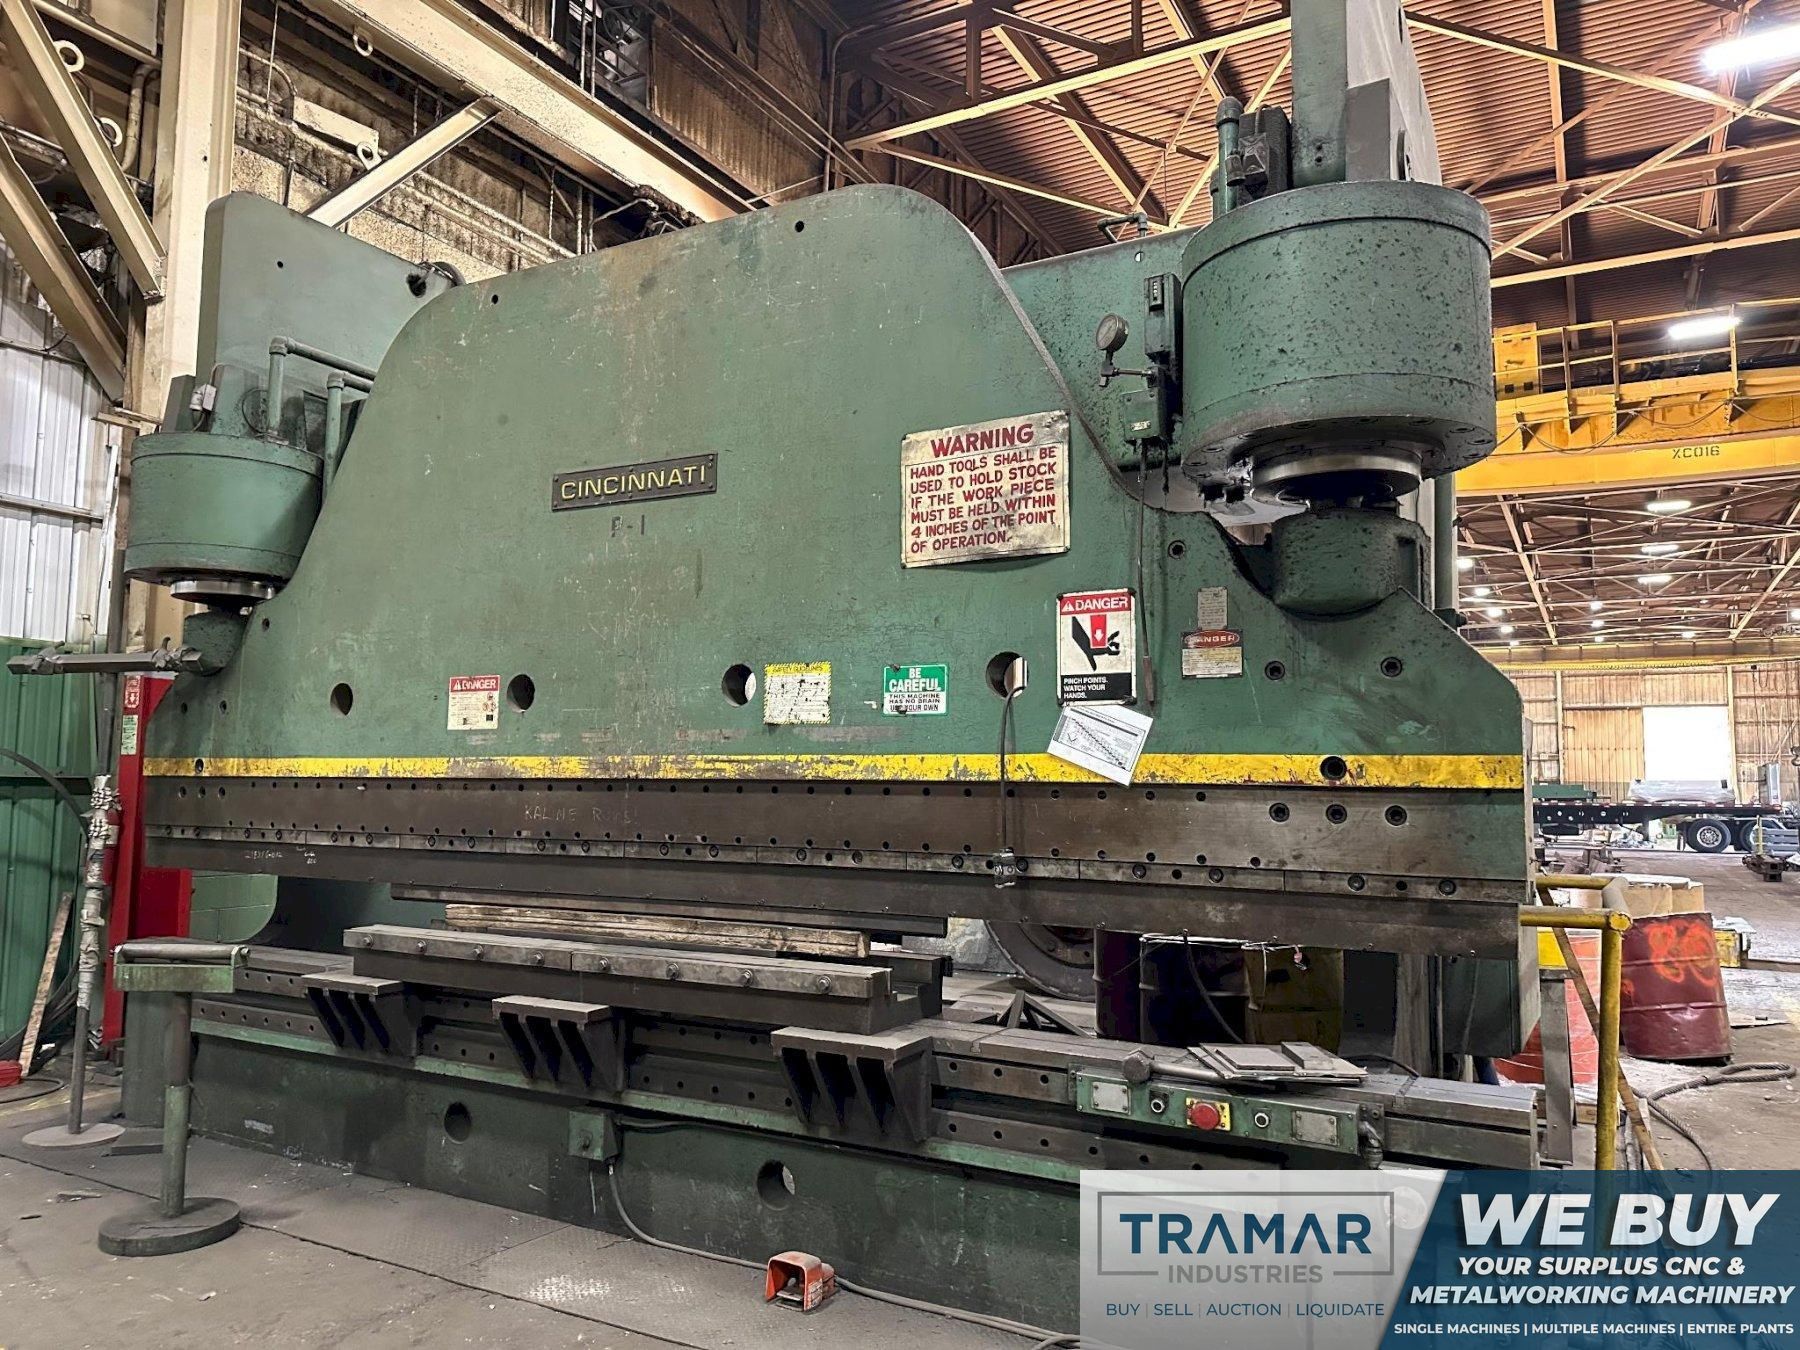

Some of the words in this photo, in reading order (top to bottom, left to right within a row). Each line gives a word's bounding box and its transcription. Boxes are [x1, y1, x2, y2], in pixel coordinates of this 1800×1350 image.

[931, 424, 1034, 458] WARNING
[1672, 446, 1720, 459] XC016
[911, 464, 944, 479] HAND
[949, 456, 987, 474] TOOLS
[994, 449, 1034, 466] SHALL
[1040, 446, 1056, 459] BE
[561, 465, 706, 500] CINCINNATI
[911, 479, 942, 494] USED
[948, 476, 964, 489] TO
[970, 470, 1003, 486] HOLD
[1009, 462, 1056, 480] STOCK
[911, 496, 922, 509] IF
[928, 492, 954, 506] THE
[963, 485, 1003, 502] WORK
[1011, 478, 1054, 495] PIECE
[911, 509, 944, 524] MUST
[949, 506, 963, 519] BE
[968, 501, 999, 516] HELD
[1005, 494, 1055, 511] WITHIN
[911, 526, 921, 538] 4
[926, 520, 968, 537] INCHES
[972, 518, 988, 531] OF
[992, 514, 1014, 528] THE
[1018, 510, 1055, 525] POINT
[911, 541, 927, 553] OF
[932, 530, 1012, 550] OPERATION.
[1075, 596, 1129, 611] DANGER
[462, 679, 497, 690] DANGER
[909, 667, 922, 679] BE
[1063, 677, 1083, 685] PINCH
[888, 678, 942, 692] CAREFUL
[1087, 683, 1106, 691] YOUR
